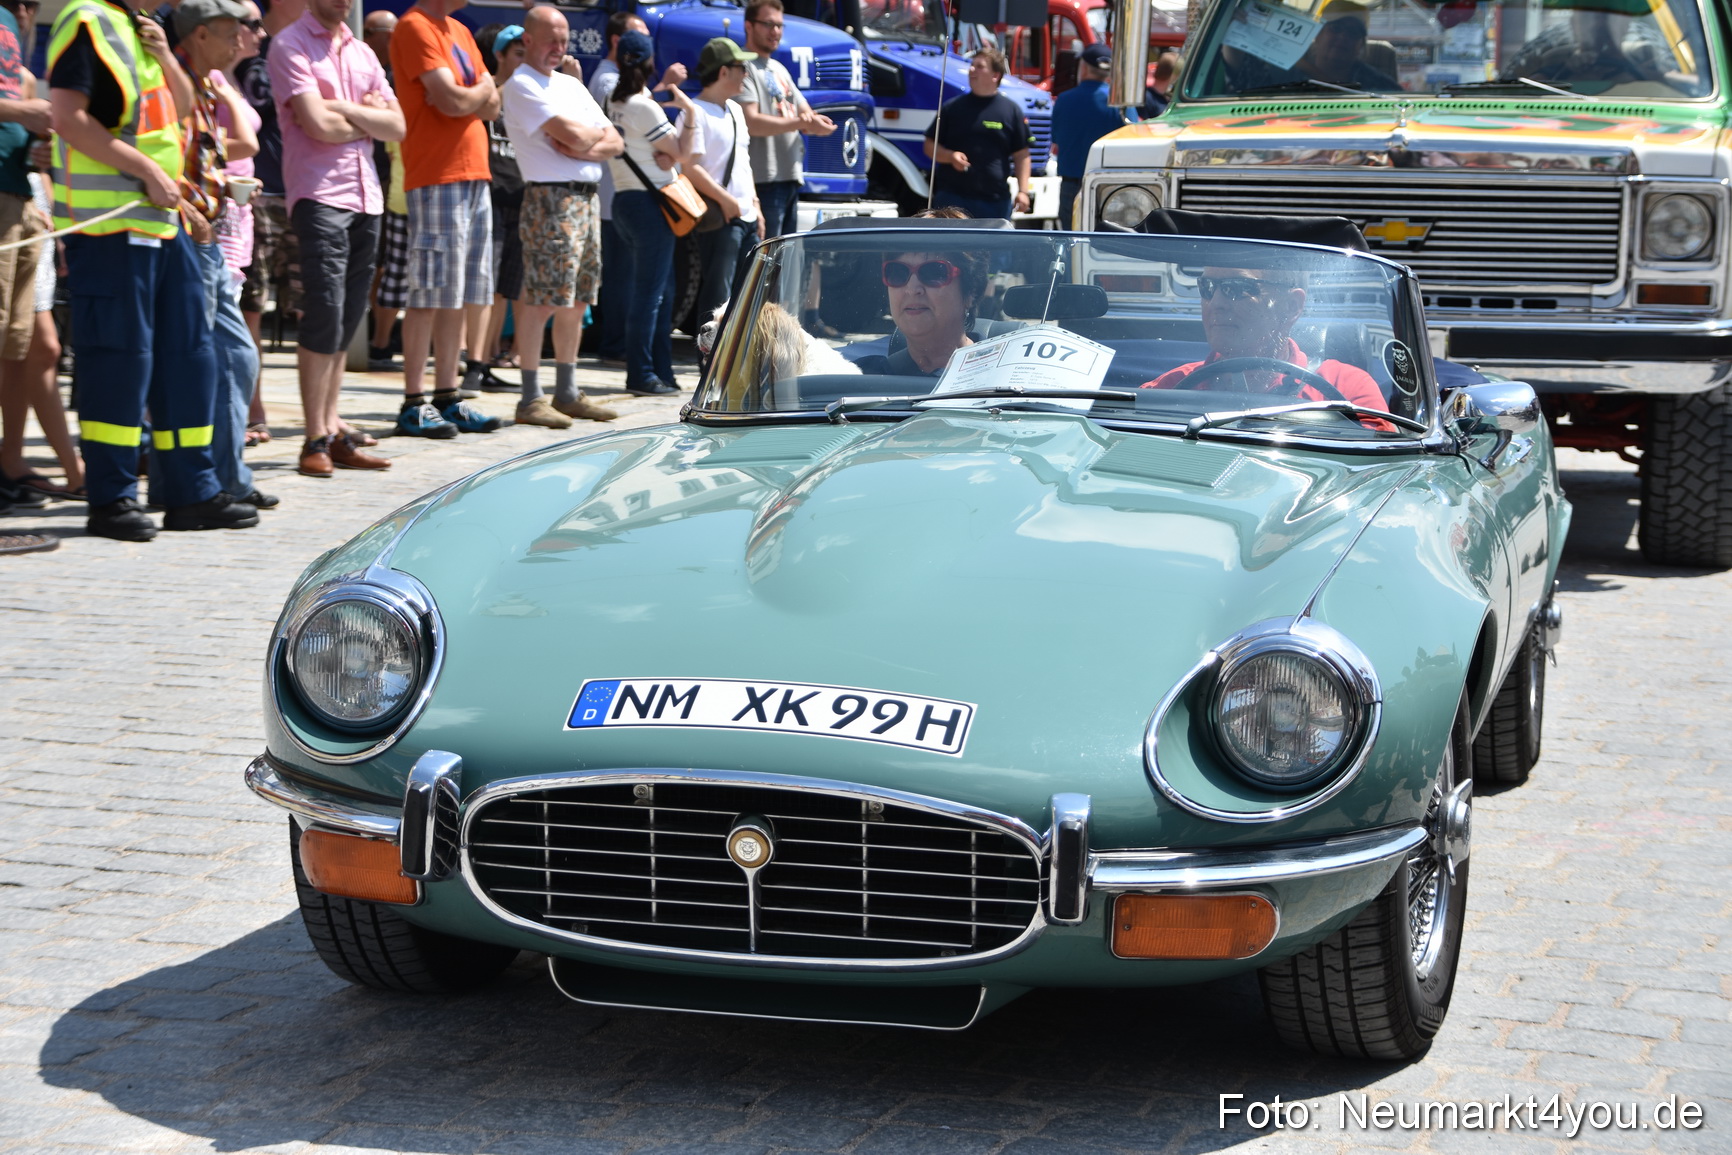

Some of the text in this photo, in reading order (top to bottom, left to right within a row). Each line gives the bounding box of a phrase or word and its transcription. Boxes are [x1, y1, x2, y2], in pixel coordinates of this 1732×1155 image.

[1276, 18, 1304, 38] 124
[1022, 341, 1078, 362] 107
[583, 708, 597, 720] D
[611, 684, 702, 720] NM
[731, 686, 822, 727] XK
